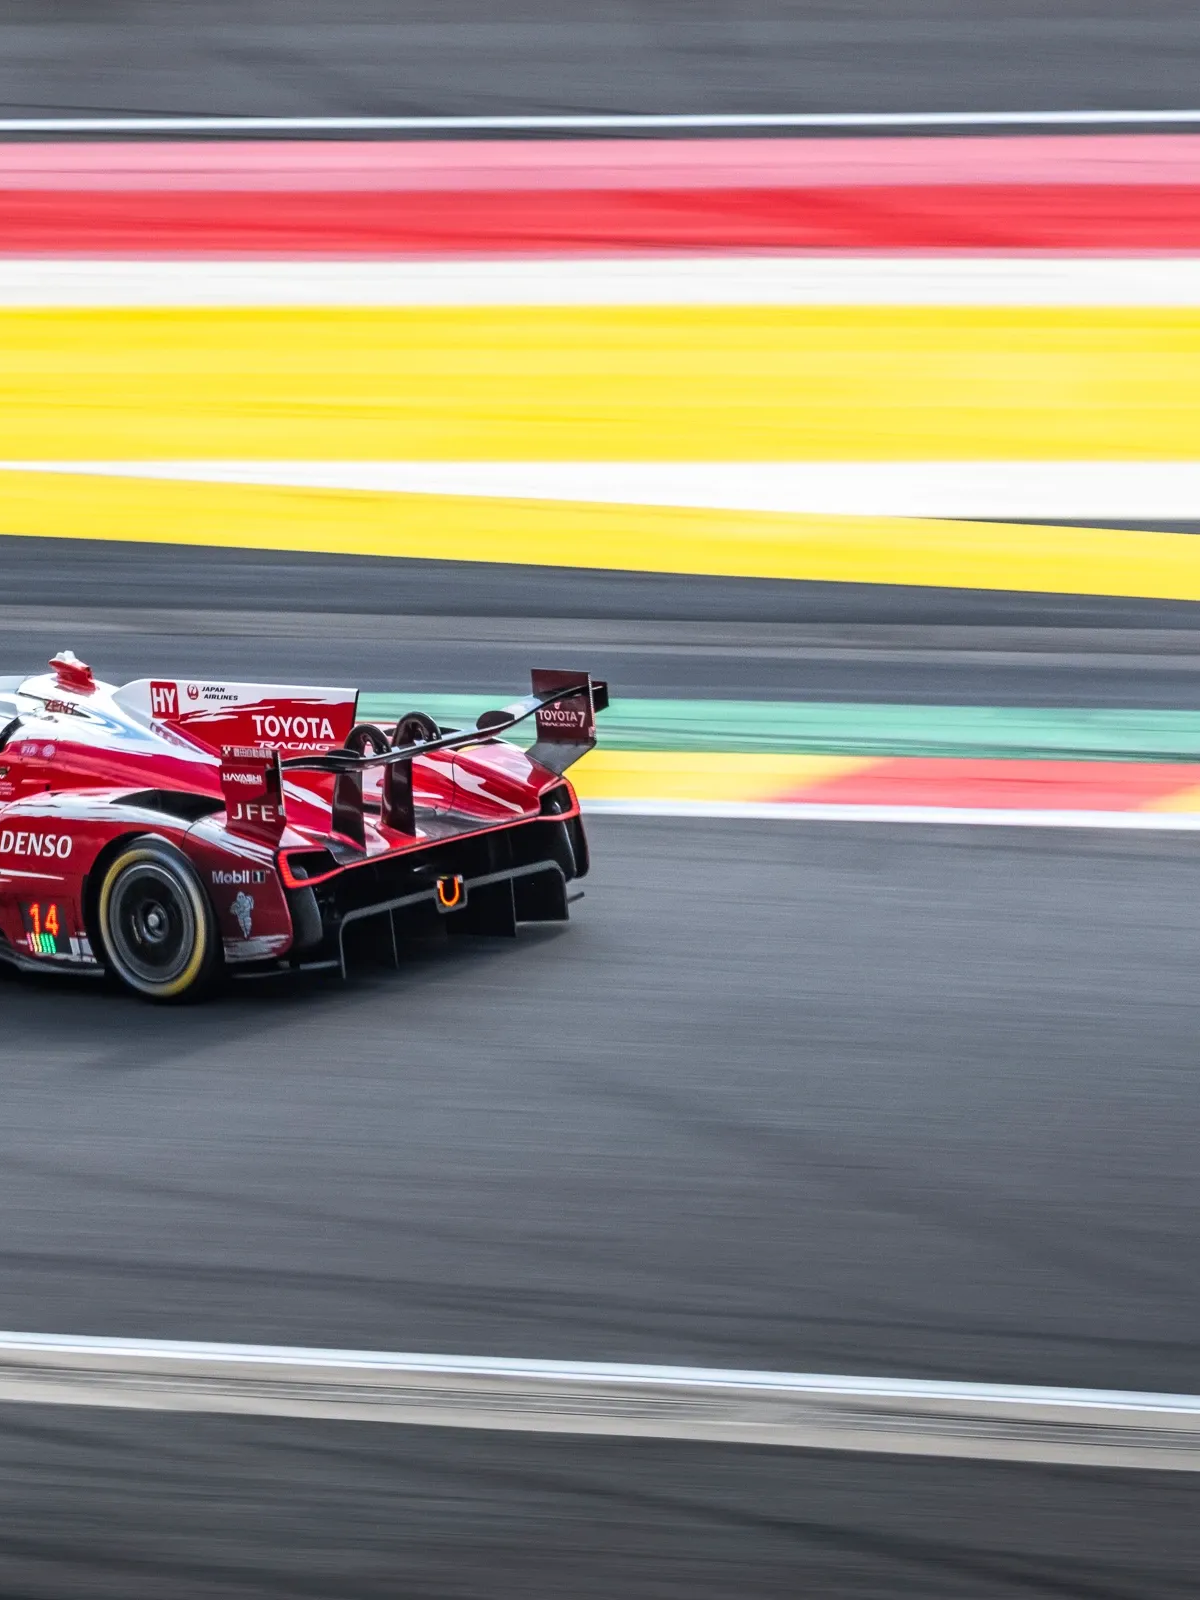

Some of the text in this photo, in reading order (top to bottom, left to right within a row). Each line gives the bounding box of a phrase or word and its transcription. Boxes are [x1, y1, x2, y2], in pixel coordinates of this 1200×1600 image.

[152, 687, 176, 713] HY
[204, 693, 238, 701] AIRLINES
[251, 715, 336, 739] TOYOTA
[538, 709, 585, 728] TOYOTA 7
[254, 740, 336, 751] RACING
[222, 772, 262, 783] HAYASHI
[231, 803, 276, 822] JFE
[0, 830, 73, 859] DENSO
[212, 870, 249, 884] Mobil
[29, 903, 59, 936] 14
